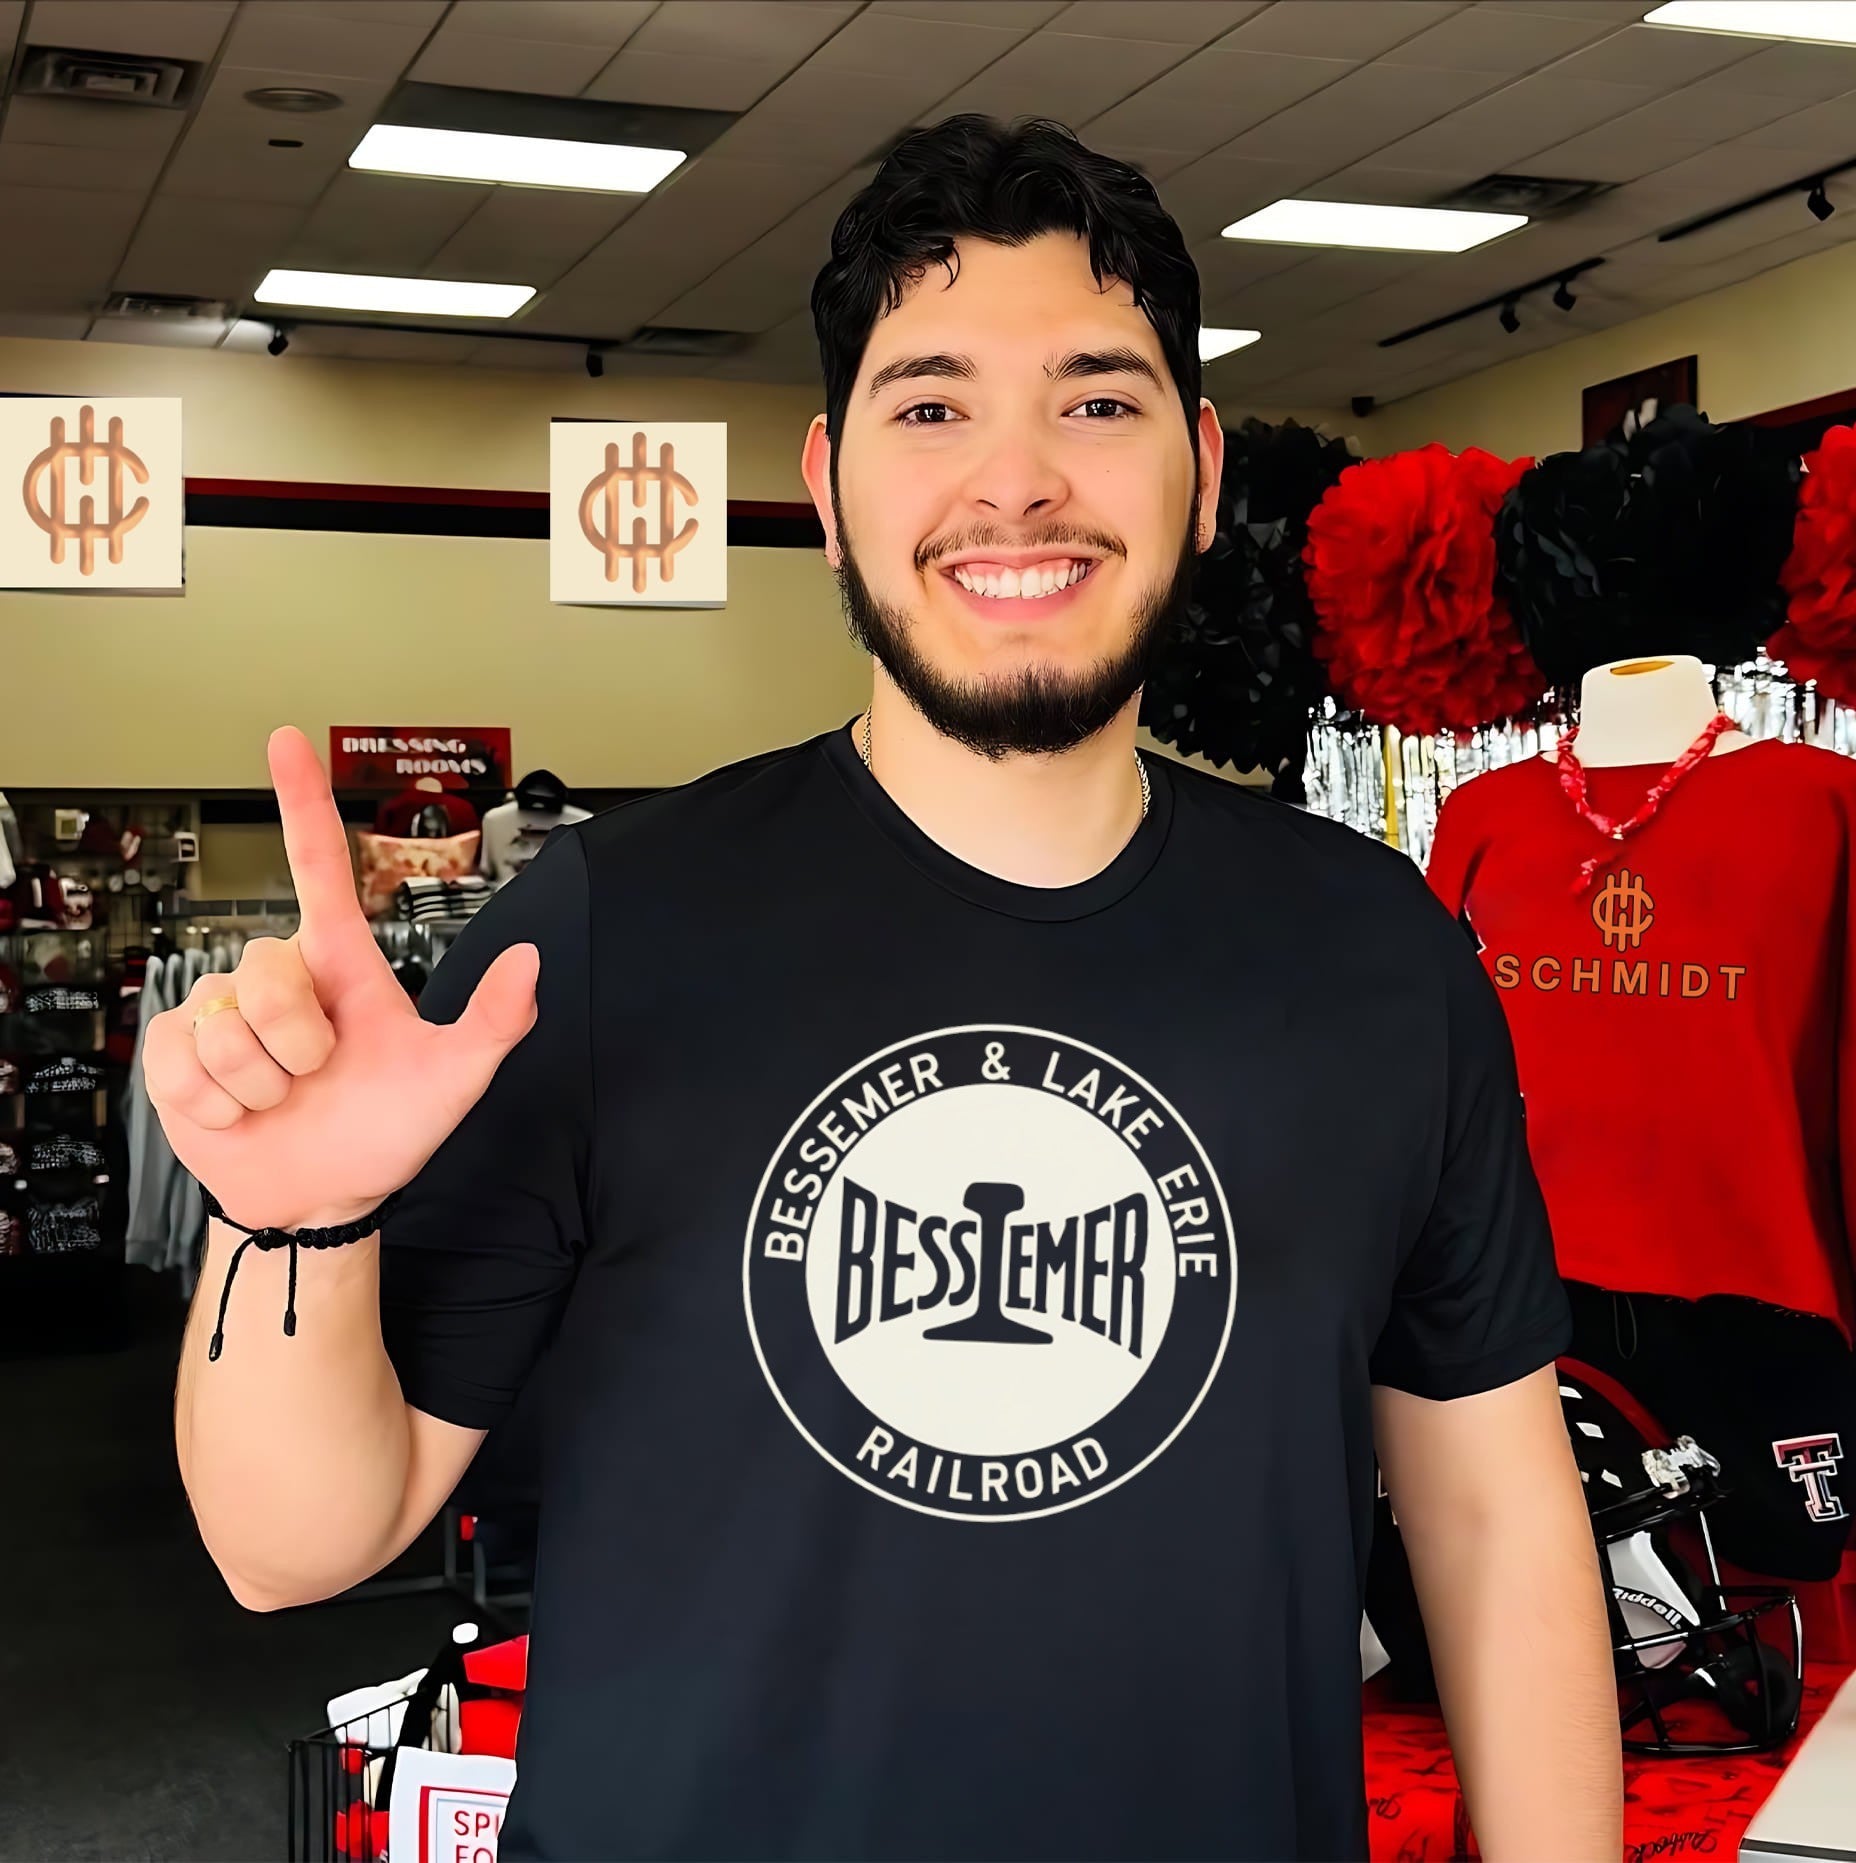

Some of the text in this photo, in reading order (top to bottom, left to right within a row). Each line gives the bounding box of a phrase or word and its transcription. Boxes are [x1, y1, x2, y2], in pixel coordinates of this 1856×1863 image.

[1494, 953, 1747, 1000] SCHMIDT
[764, 1041, 1218, 1278] BESSEMER & LAKE ERIE
[856, 1425, 1109, 1502] RAILROAD
